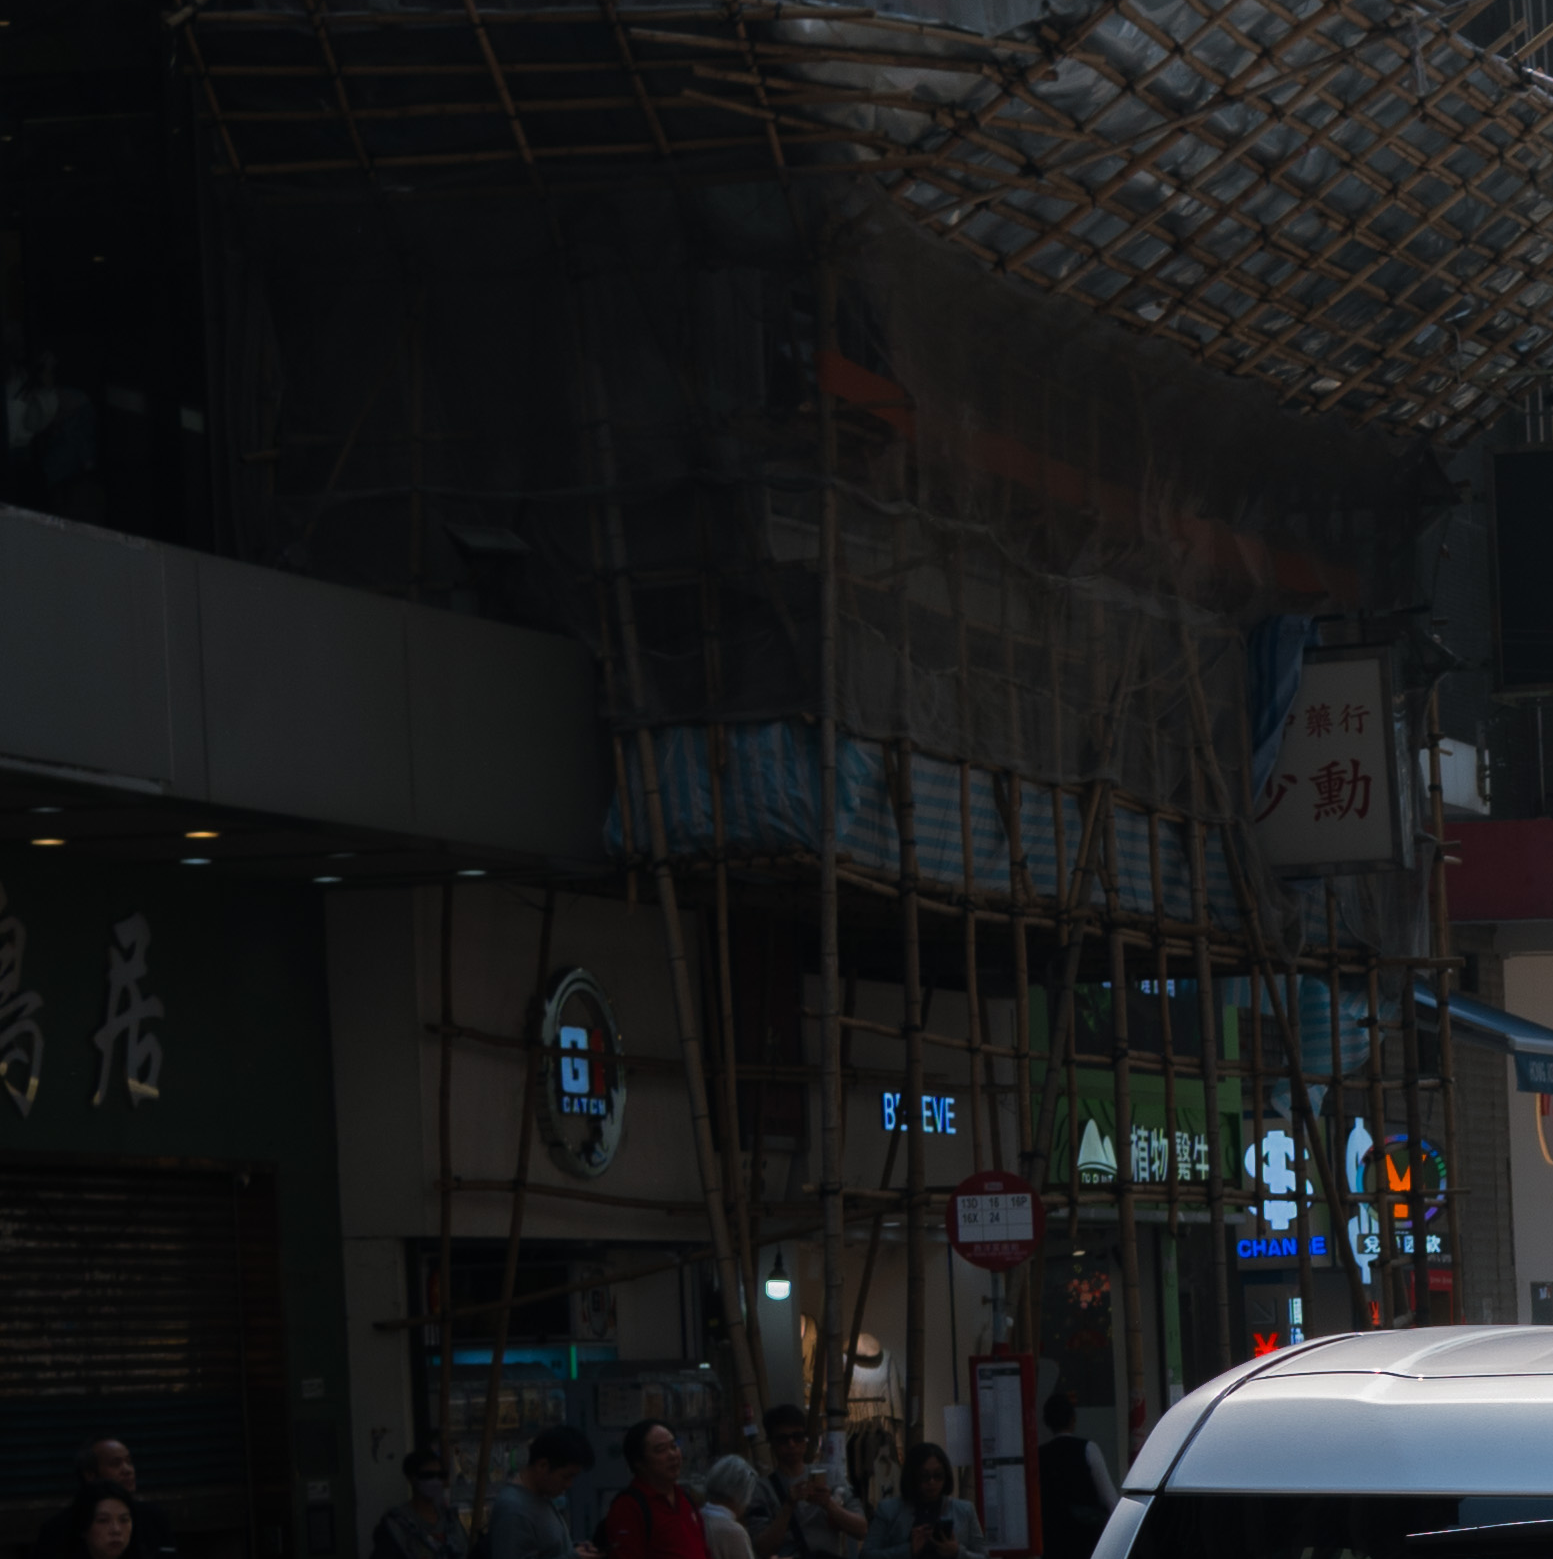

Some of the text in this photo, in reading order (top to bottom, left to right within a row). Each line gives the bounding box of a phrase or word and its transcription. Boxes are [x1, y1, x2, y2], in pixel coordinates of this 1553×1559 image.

[561, 1096, 608, 1115] CATCH
[963, 1212, 1000, 1224] 16X 24
[1237, 1236, 1328, 1259] CHANE
